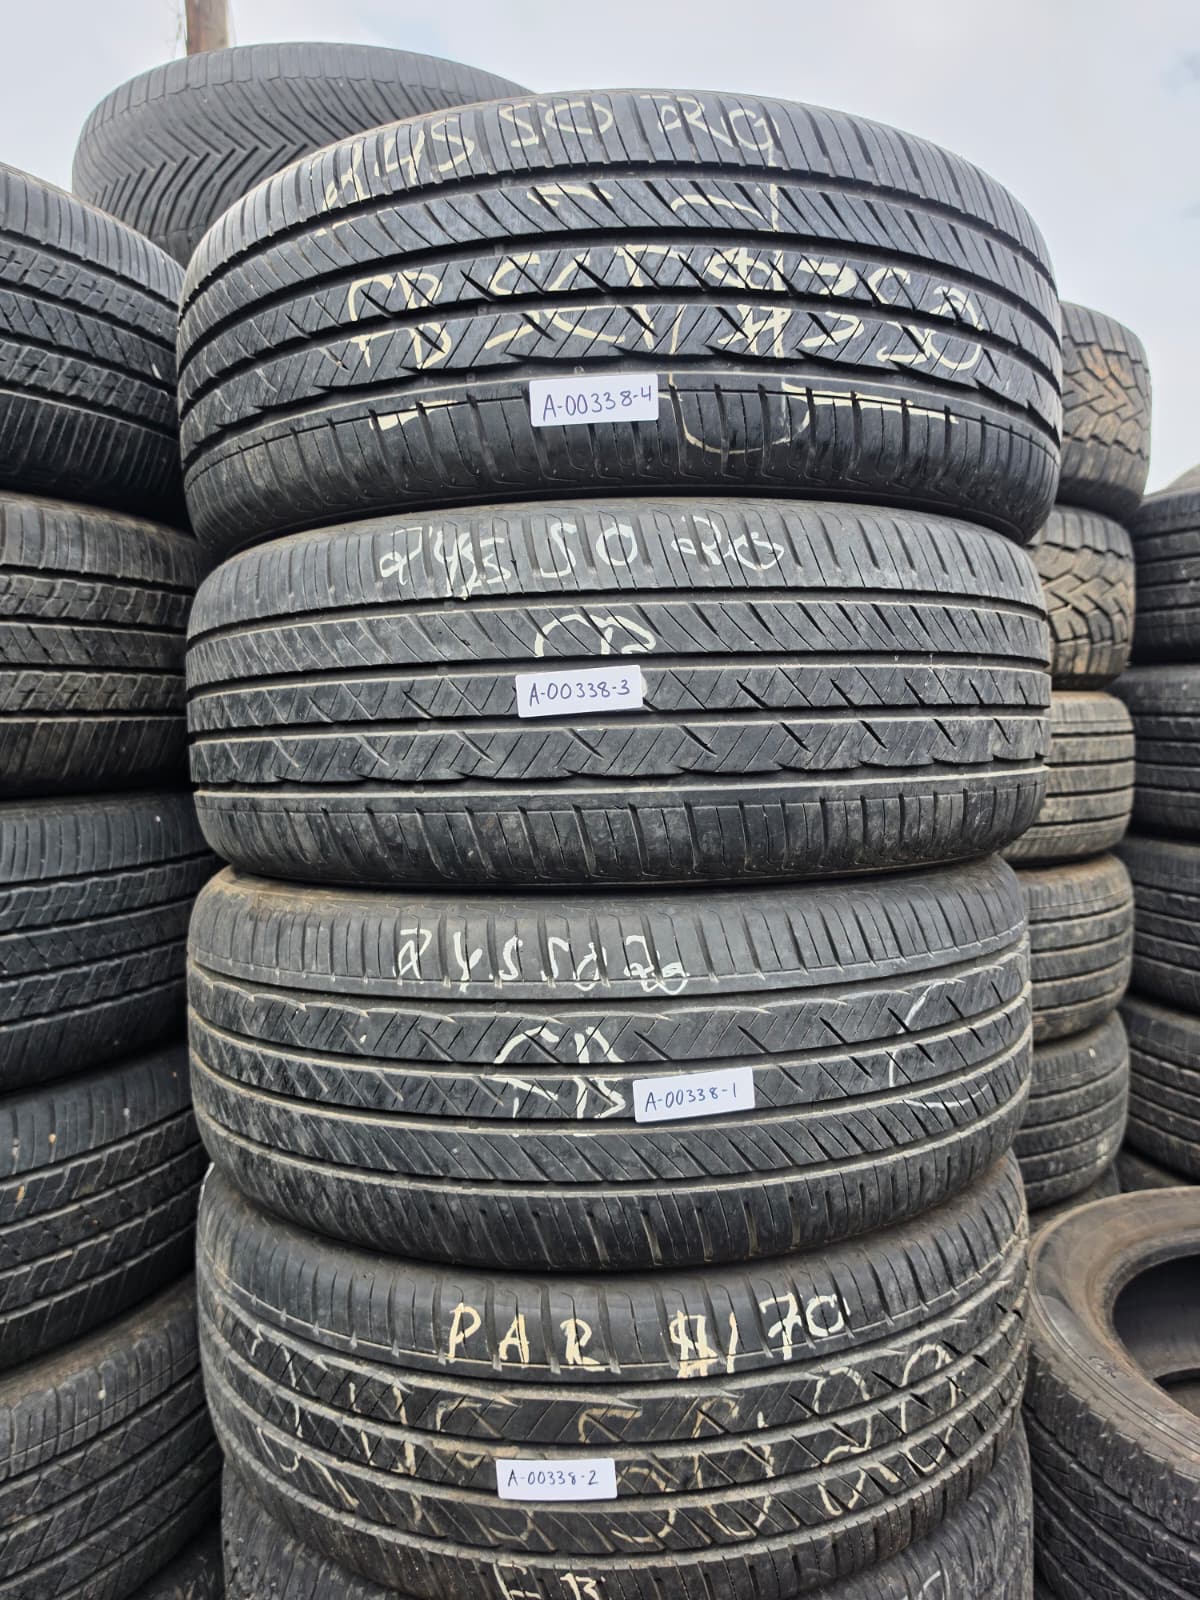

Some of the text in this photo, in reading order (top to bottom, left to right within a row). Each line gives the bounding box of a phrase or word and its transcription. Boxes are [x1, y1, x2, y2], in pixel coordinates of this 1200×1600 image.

[542, 385, 652, 421] A-00338-4
[539, 522, 638, 578] 50
[528, 678, 632, 706] A-00338-3
[644, 1083, 737, 1112] A-00338-1
[507, 1469, 600, 1487] A-00338-2
